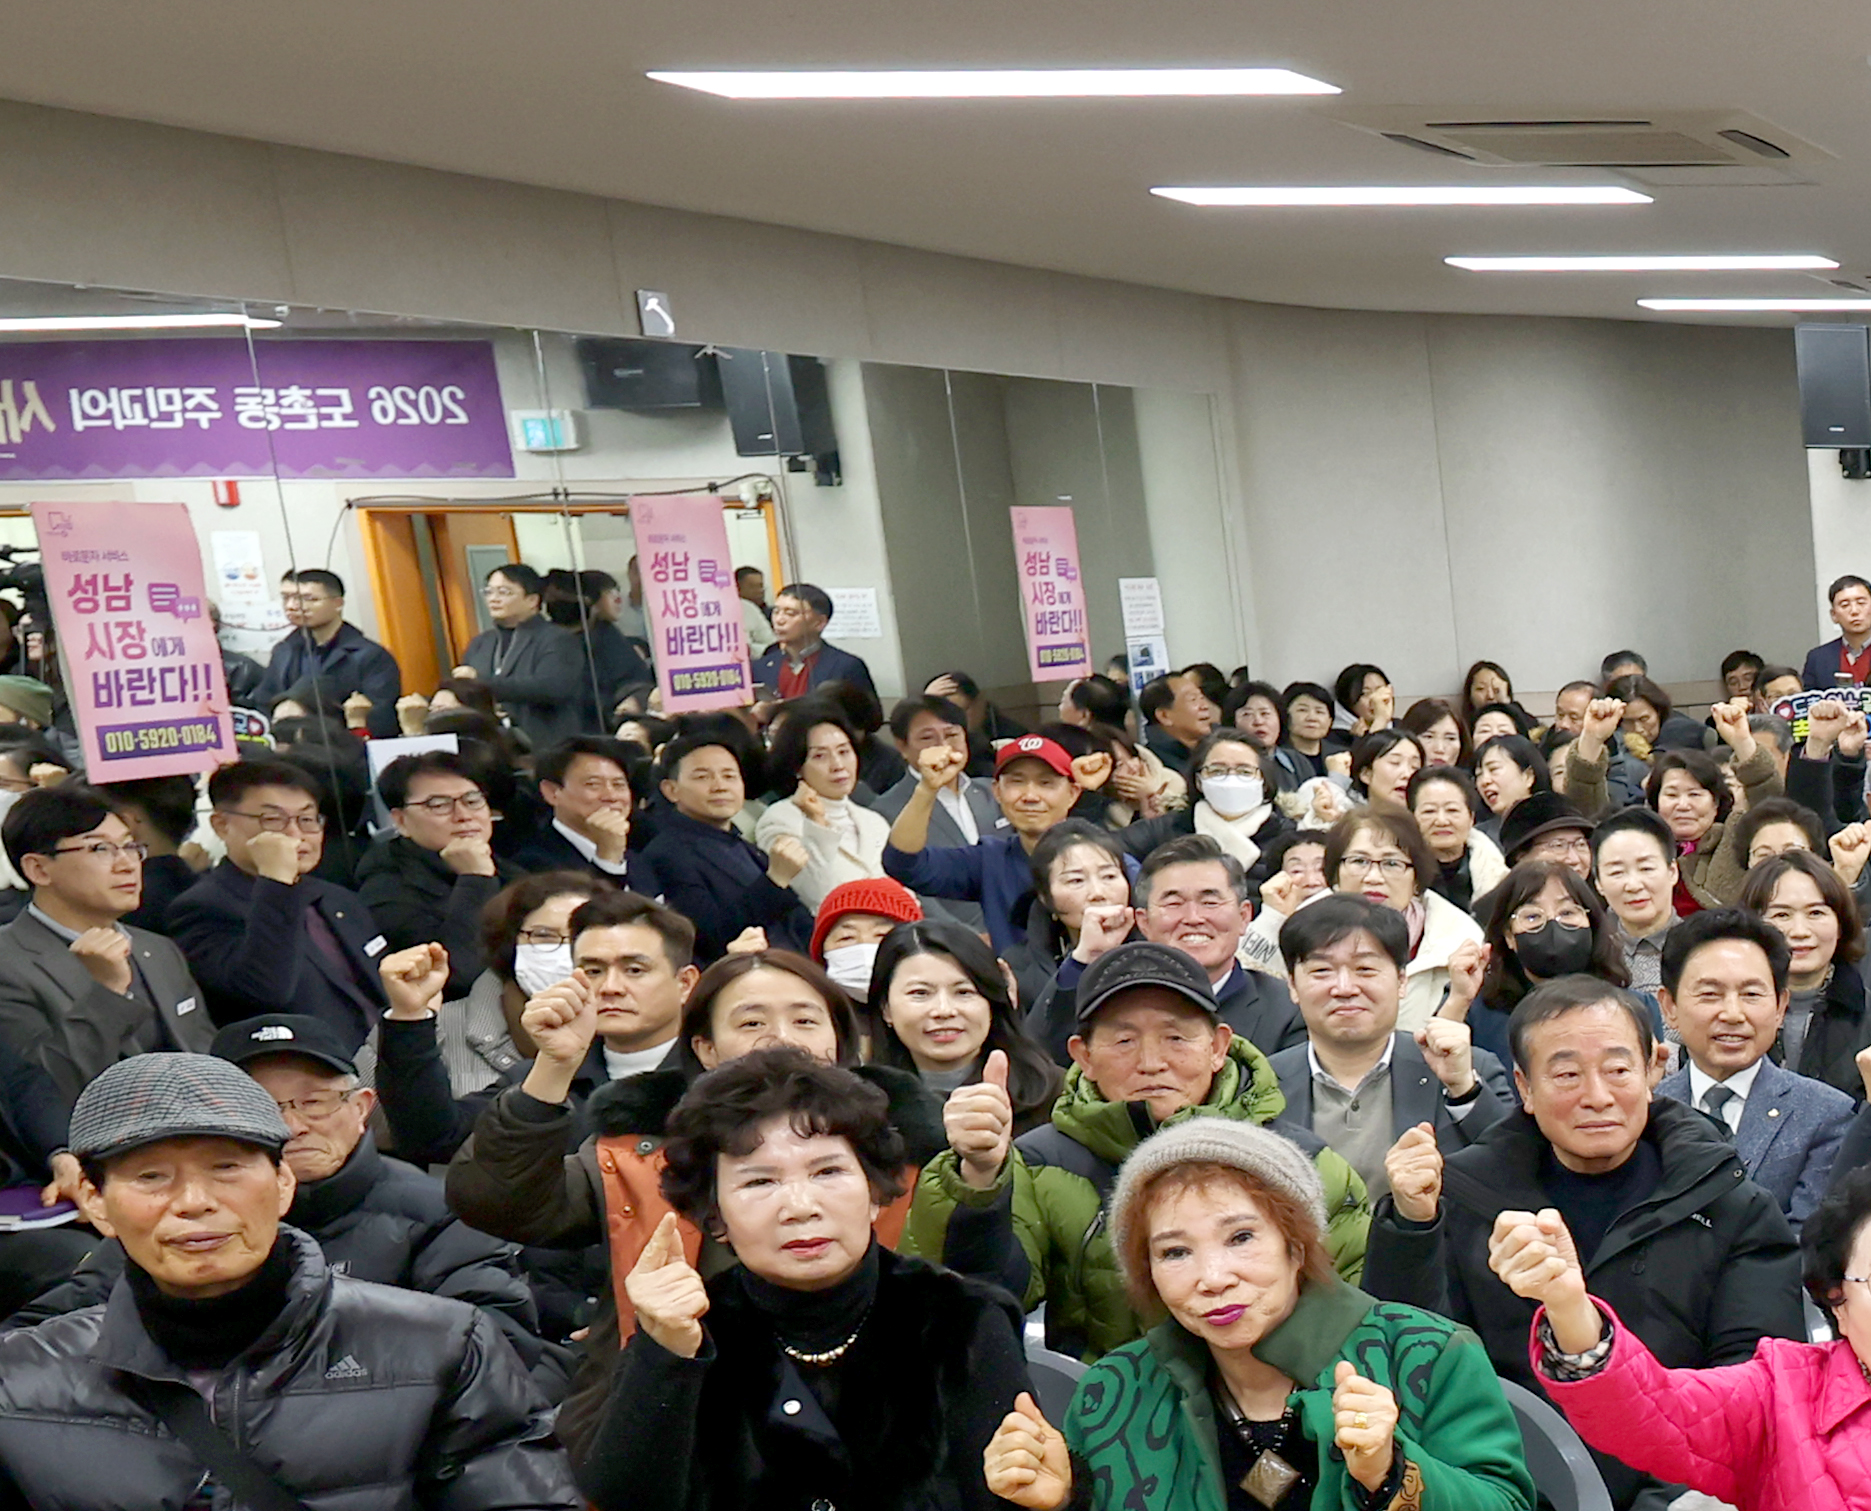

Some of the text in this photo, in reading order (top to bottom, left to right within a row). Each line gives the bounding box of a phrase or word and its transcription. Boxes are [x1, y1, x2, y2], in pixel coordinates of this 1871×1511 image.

[651, 551, 690, 583] 성남
[1025, 551, 1051, 577] 성남
[67, 572, 134, 615] 성남
[665, 621, 740, 657] 바란다!!
[92, 662, 213, 709] 바란다!!
[104, 723, 218, 754] 010-5920-0184
[325, 1367, 368, 1380] adidas
